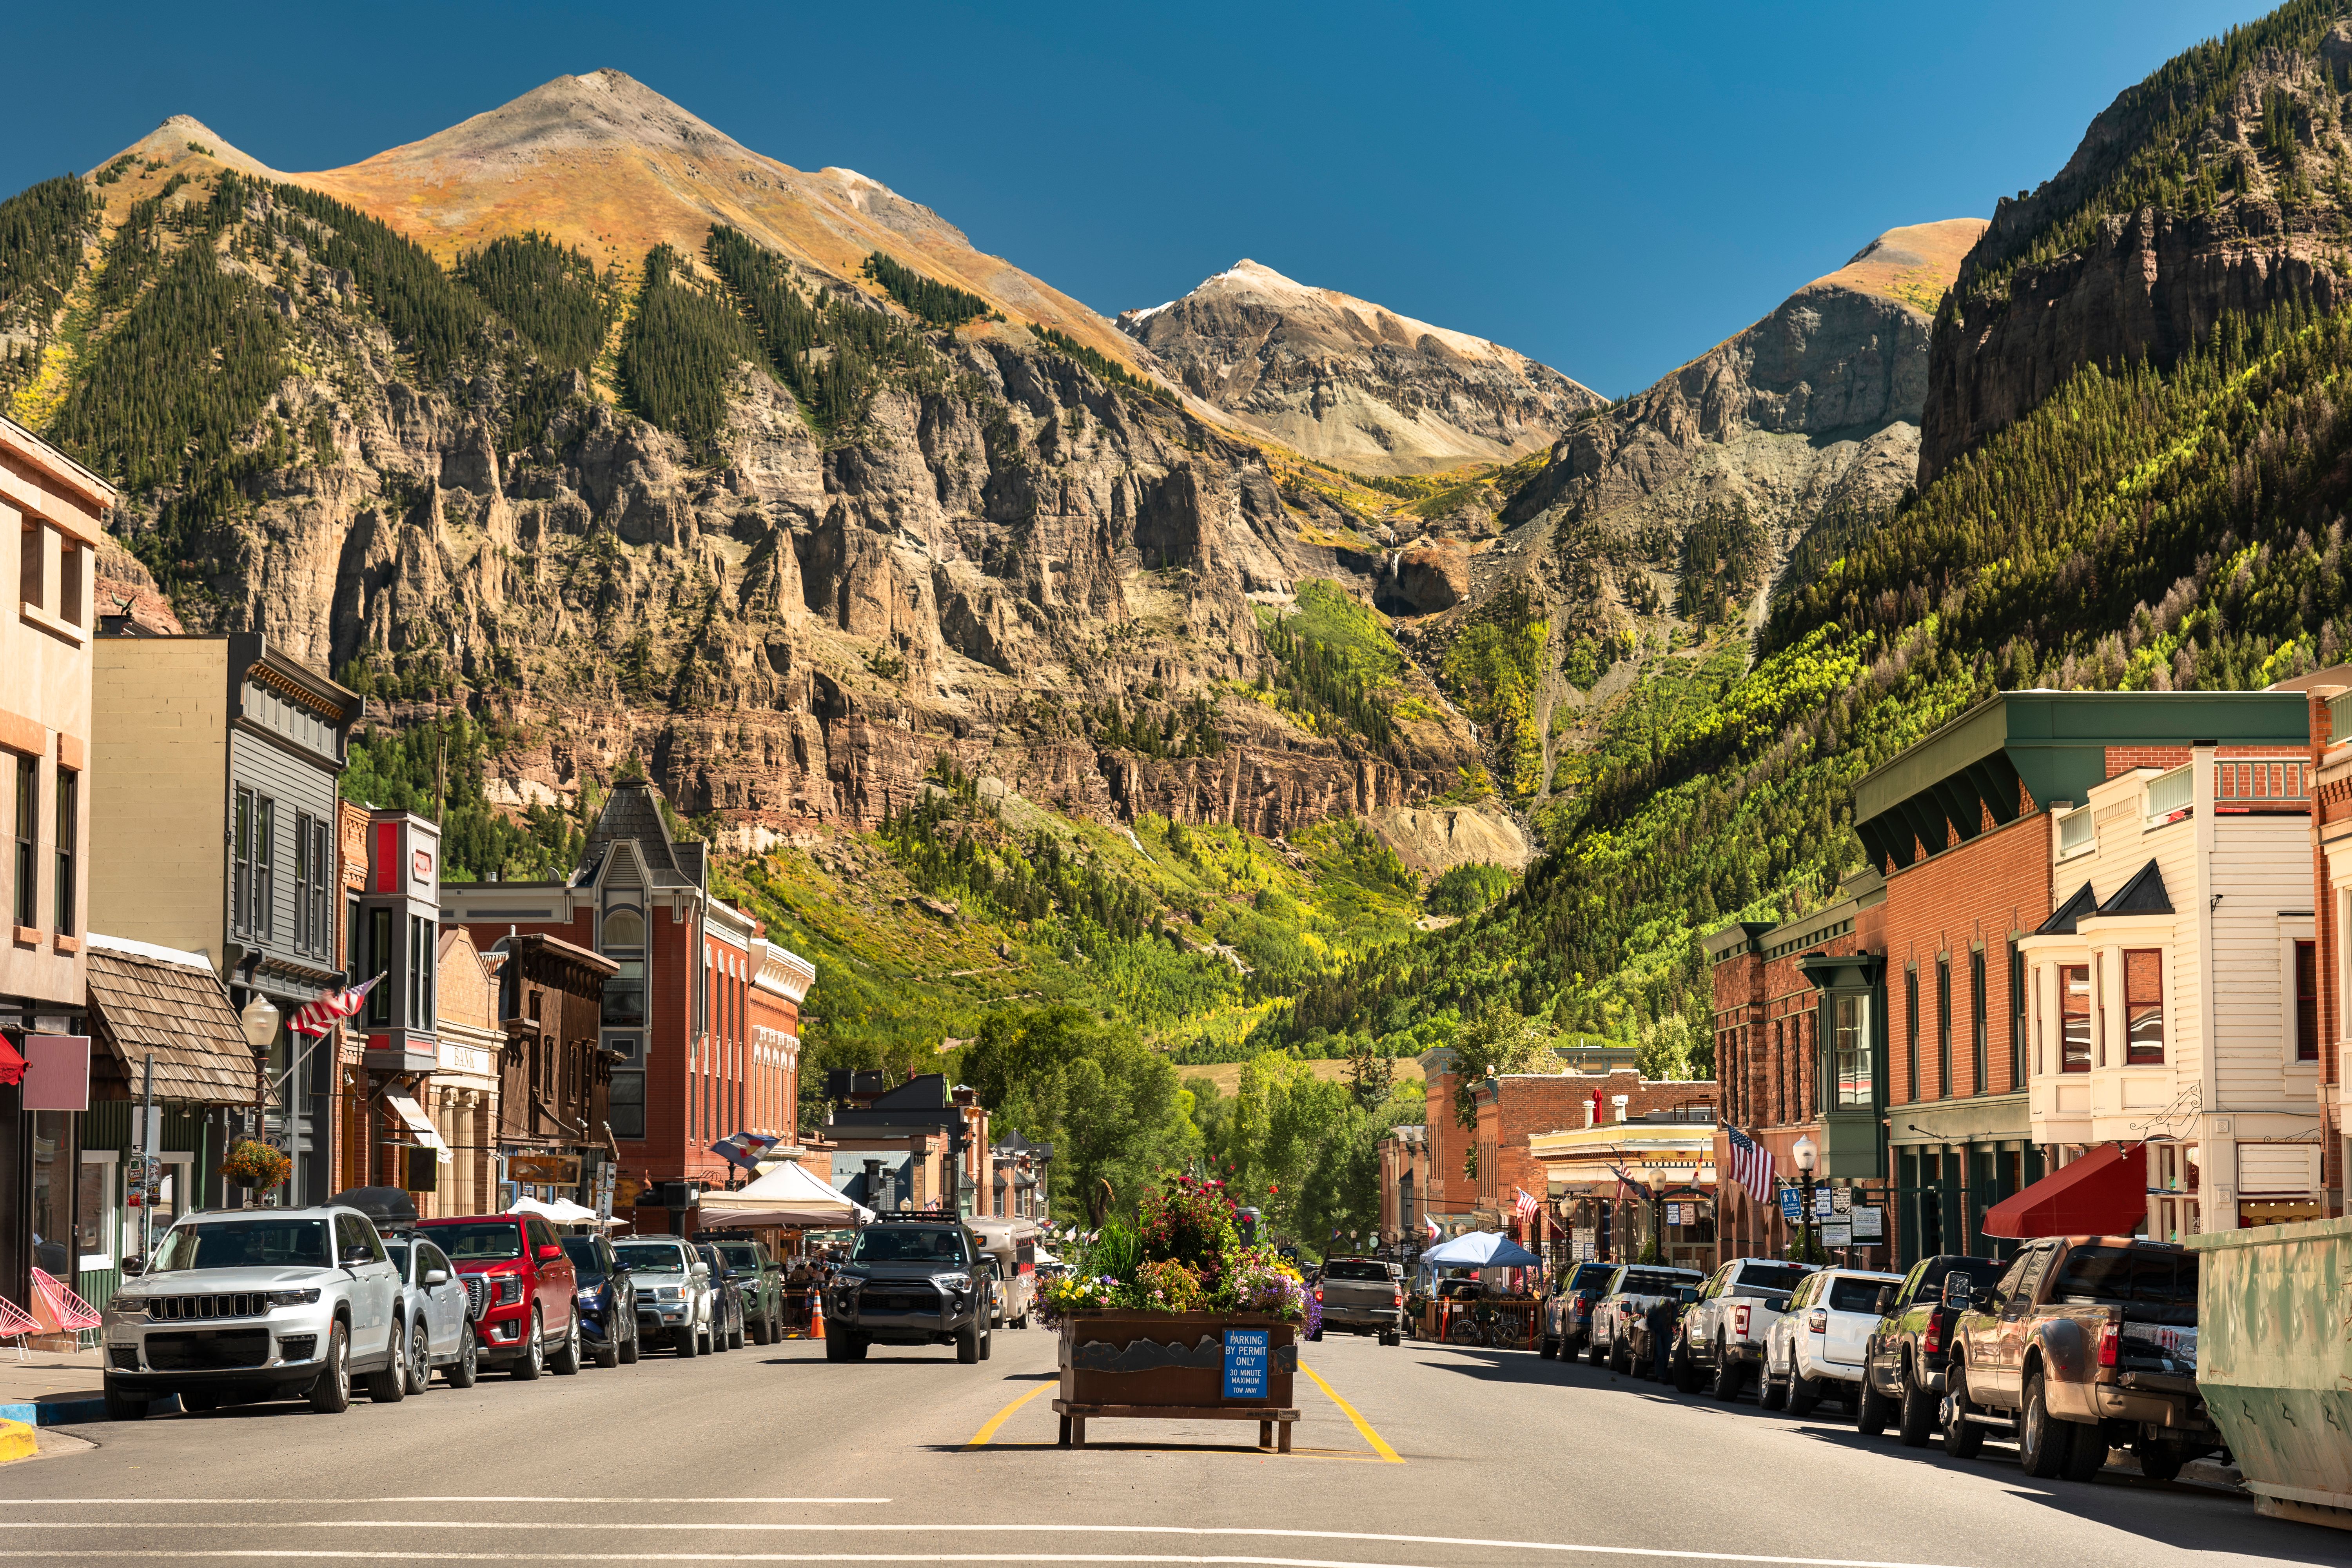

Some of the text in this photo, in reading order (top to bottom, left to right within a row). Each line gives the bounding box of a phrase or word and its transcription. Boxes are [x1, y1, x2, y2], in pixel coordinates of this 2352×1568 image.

[455, 1048, 474, 1068] BANK
[1230, 1336, 1262, 1345] PARKING
[1225, 1346, 1267, 1356] BY PERMIT
[1236, 1357, 1255, 1366] ONLY
